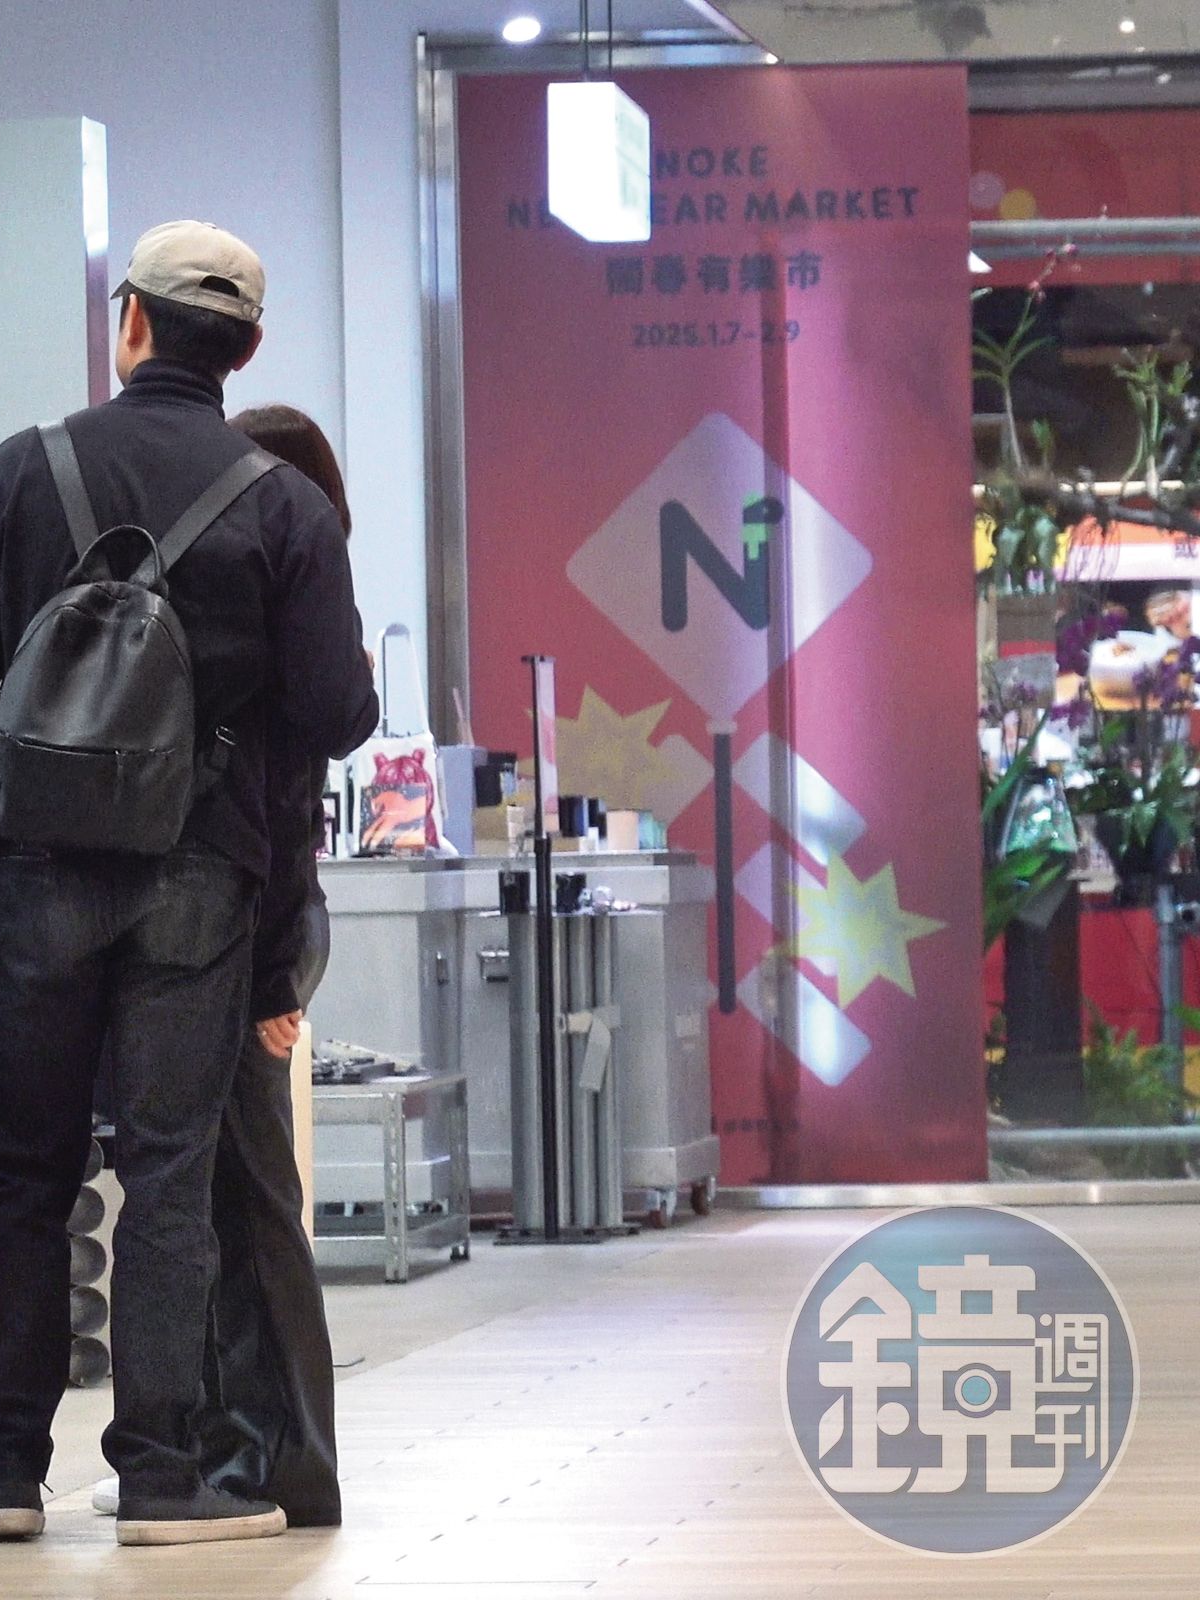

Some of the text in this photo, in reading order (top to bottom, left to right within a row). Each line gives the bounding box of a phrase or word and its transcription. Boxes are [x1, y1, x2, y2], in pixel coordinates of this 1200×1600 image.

[655, 146, 768, 179] NOKE
[651, 192, 728, 225] EAR
[743, 187, 918, 223] MARKET
